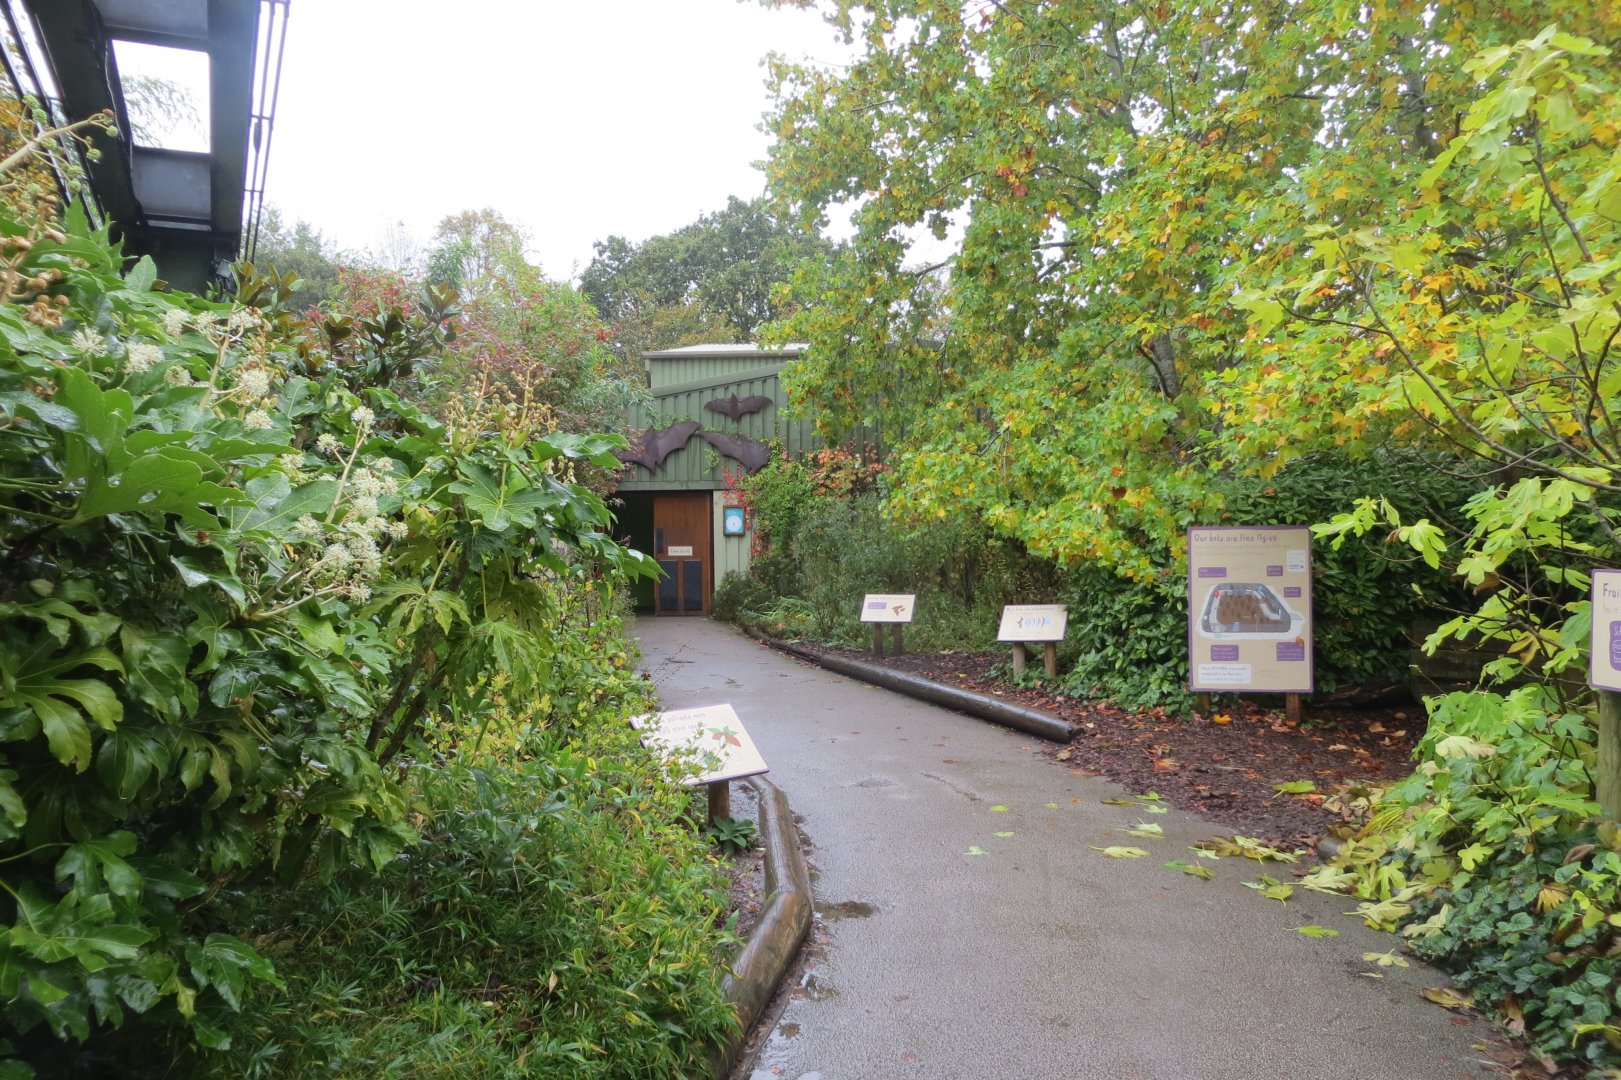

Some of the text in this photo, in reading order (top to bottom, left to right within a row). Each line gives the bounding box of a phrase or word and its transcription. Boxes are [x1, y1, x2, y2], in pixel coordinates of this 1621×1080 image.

[1194, 533, 1207, 542] Our
[1240, 534, 1254, 542] free
[1603, 582, 1621, 598] Frui
